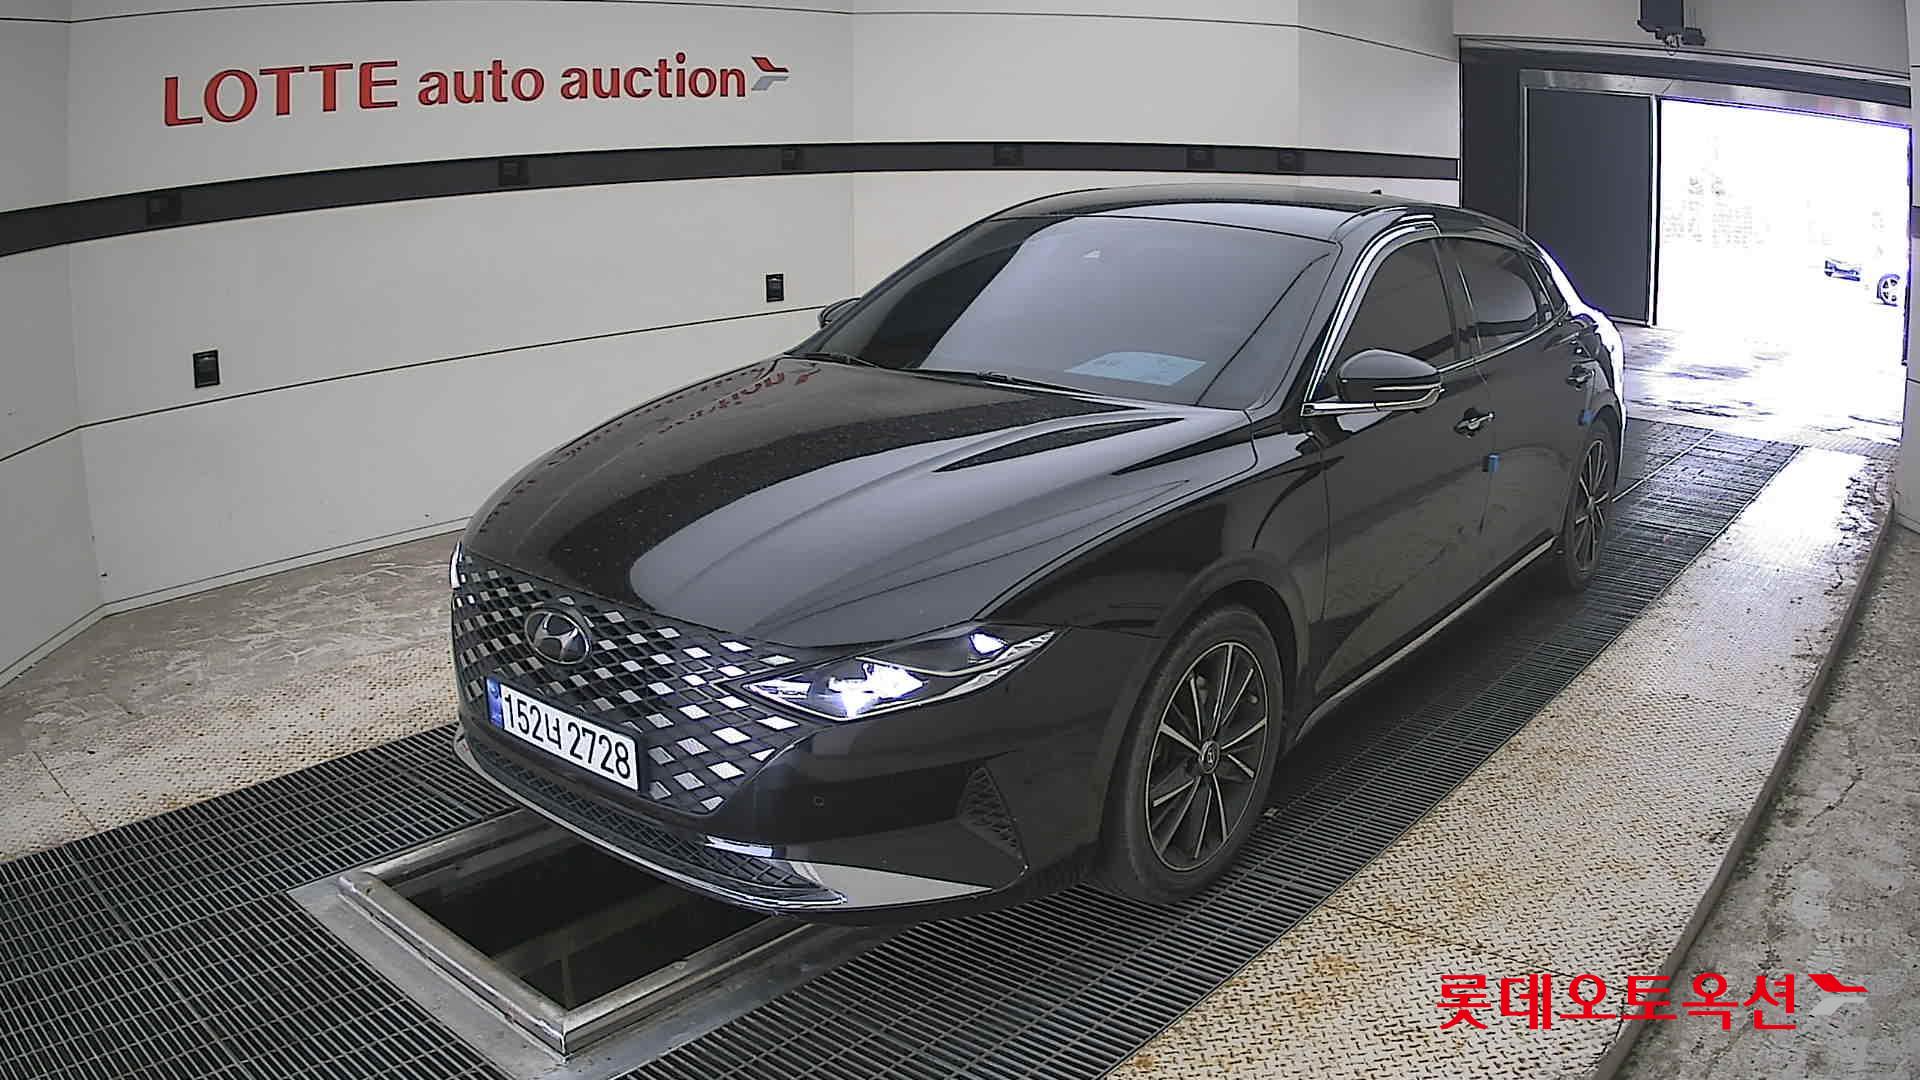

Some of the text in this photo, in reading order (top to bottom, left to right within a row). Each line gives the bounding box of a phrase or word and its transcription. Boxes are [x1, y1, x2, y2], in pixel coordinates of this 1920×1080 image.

[163, 52, 748, 127] LOTTE auto auction
[503, 694, 631, 779] 152너 2728
